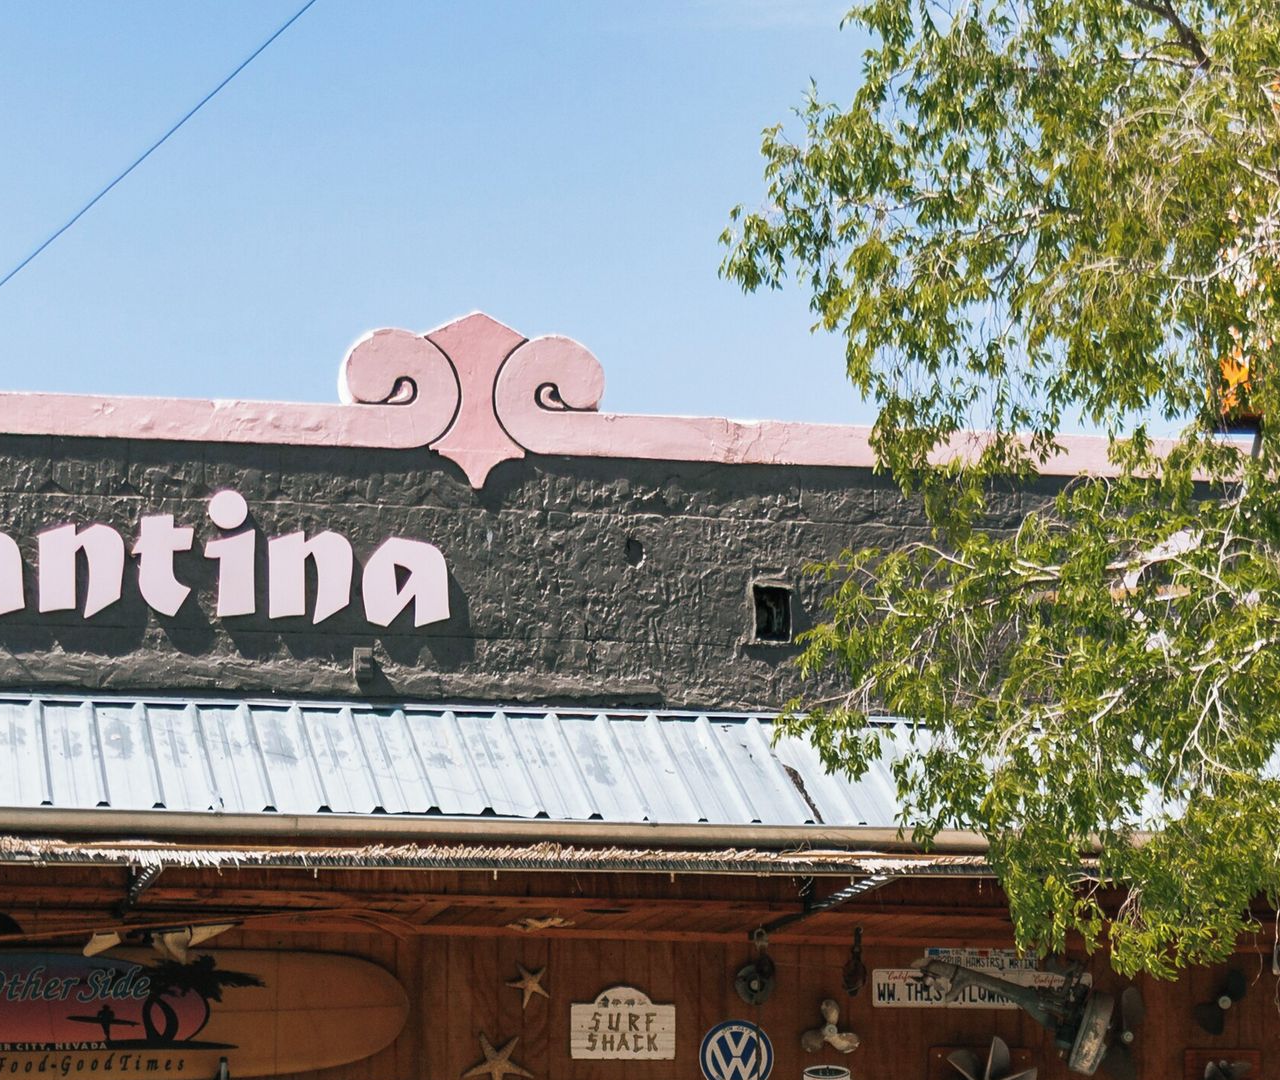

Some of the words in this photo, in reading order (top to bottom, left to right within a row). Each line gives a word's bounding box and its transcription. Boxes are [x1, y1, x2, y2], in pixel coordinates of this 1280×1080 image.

[78, 966, 151, 1003] Side
[591, 1012, 658, 1032] SURF
[16, 1043, 51, 1052] CITY,
[55, 1042, 107, 1051] NEVADA
[587, 1032, 659, 1052] SHACK
